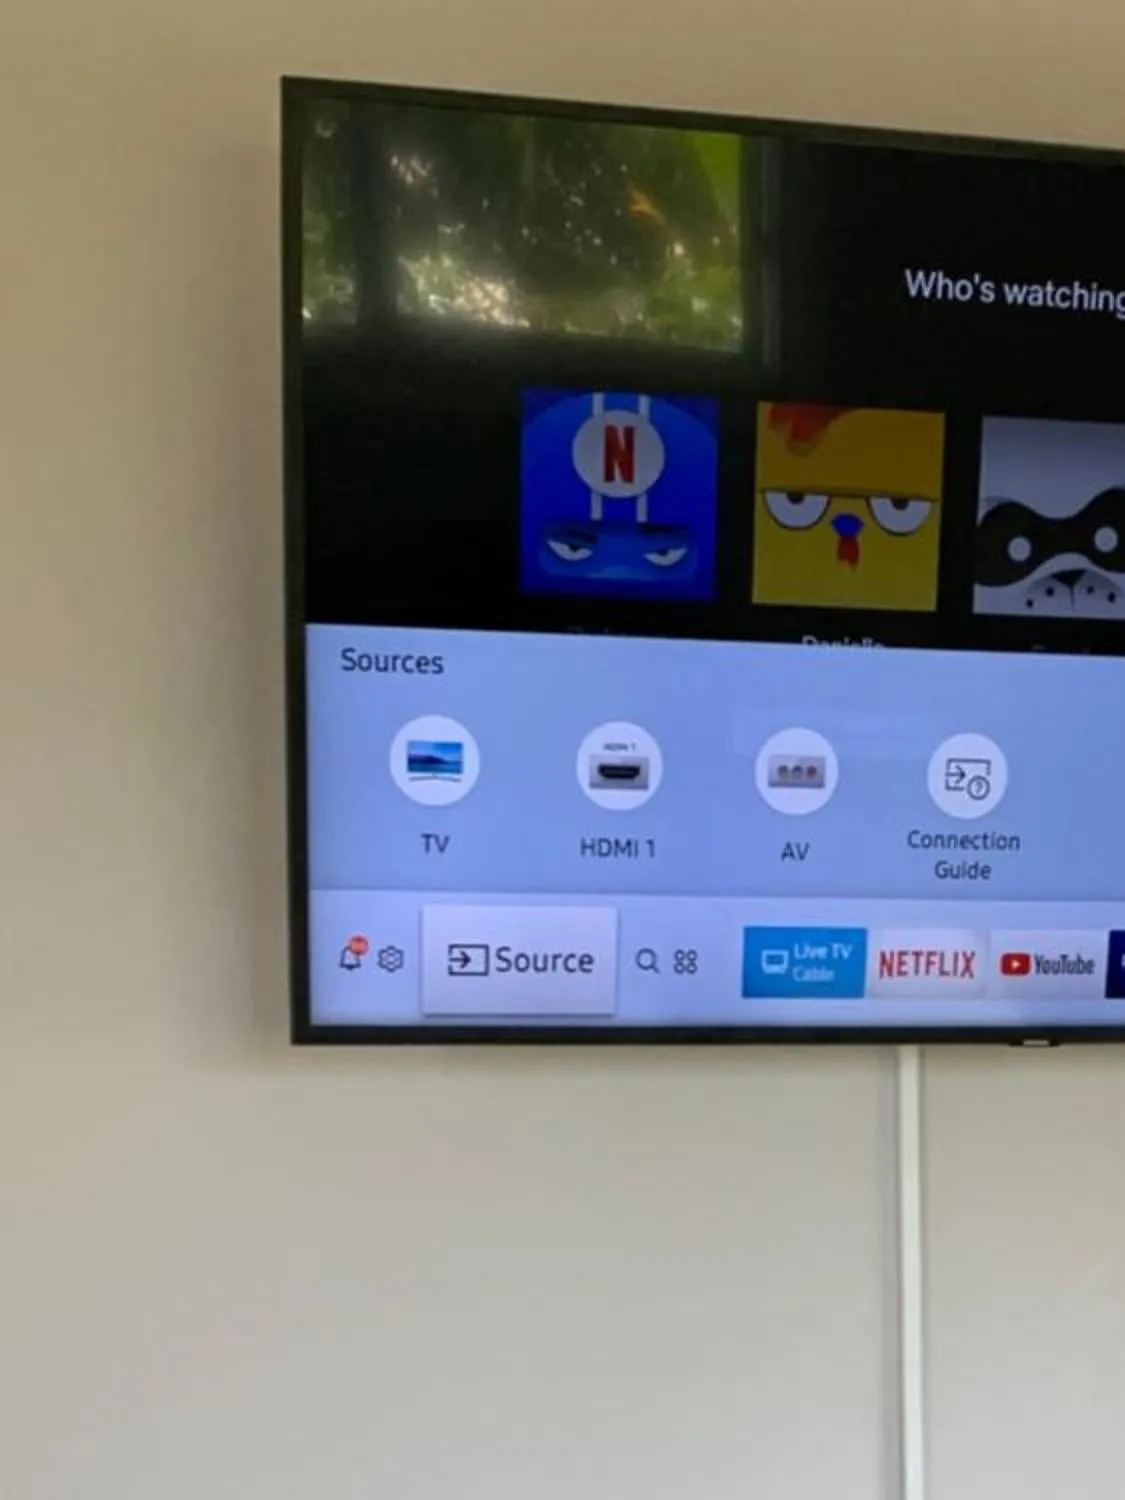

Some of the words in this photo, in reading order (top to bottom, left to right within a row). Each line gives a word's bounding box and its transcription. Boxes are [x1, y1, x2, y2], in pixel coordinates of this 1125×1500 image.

[904, 269, 996, 303] Who's
[604, 425, 635, 484] N
[340, 647, 445, 674] Sources
[420, 833, 450, 854] TV
[580, 837, 639, 858] HDMI
[645, 839, 656, 858] 1
[781, 842, 810, 861] AV
[907, 830, 1021, 851] Connection
[934, 860, 992, 880] Guide
[495, 946, 595, 973] Source
[831, 943, 852, 959] TV
[878, 949, 976, 979] NETFLIX
[1033, 953, 1095, 976] YouTube
